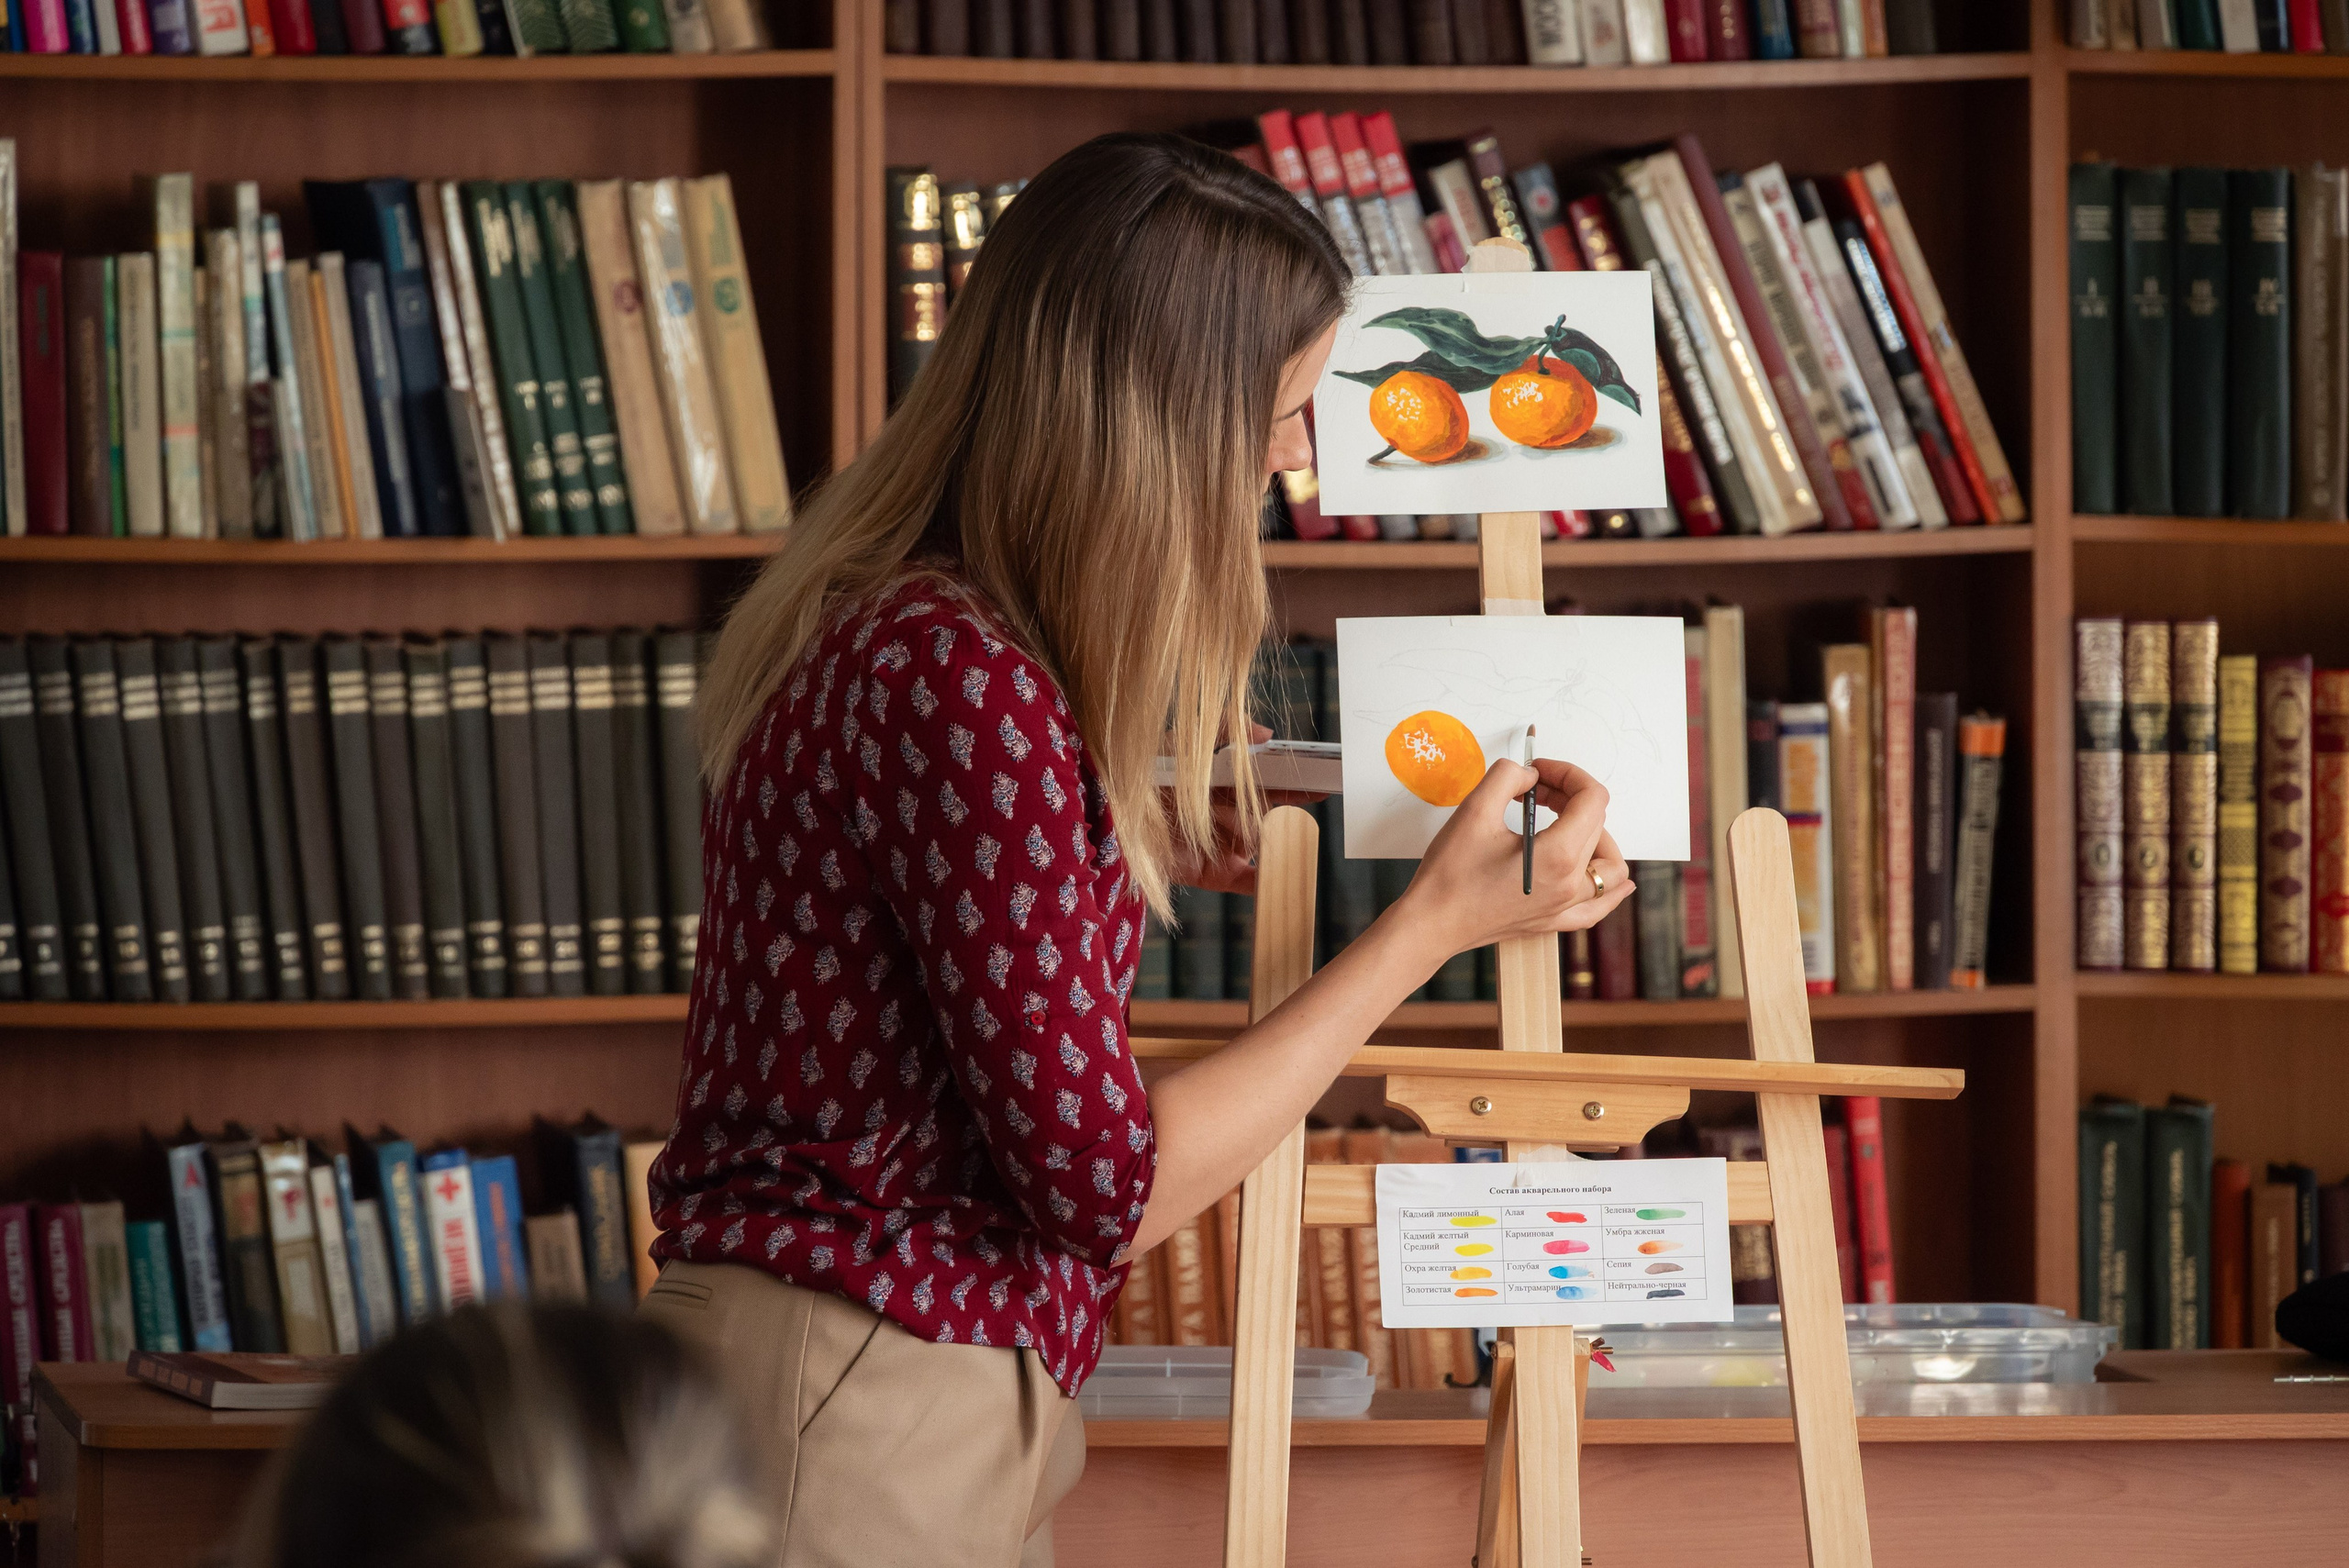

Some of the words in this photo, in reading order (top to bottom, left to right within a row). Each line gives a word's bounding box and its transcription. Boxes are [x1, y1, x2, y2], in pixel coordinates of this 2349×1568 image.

[1489, 1186, 1520, 1195] Состав
[1521, 1186, 1580, 1195] акварельного
[1582, 1185, 1612, 1194] набора
[1402, 1209, 1435, 1218] Кадмий
[1436, 1209, 1480, 1218] лимонный
[1403, 1231, 1436, 1240] Кадмий
[1437, 1231, 1469, 1240] желтый
[1505, 1230, 1554, 1240] Карминовая
[1605, 1228, 1632, 1237] Умбра
[1403, 1243, 1440, 1251] Средний
[1404, 1264, 1427, 1273] Охра
[1506, 1262, 1540, 1272] Голубая
[1508, 1284, 1561, 1294] Ультрамарин
[1608, 1282, 1687, 1291] Нейтрально-черная
